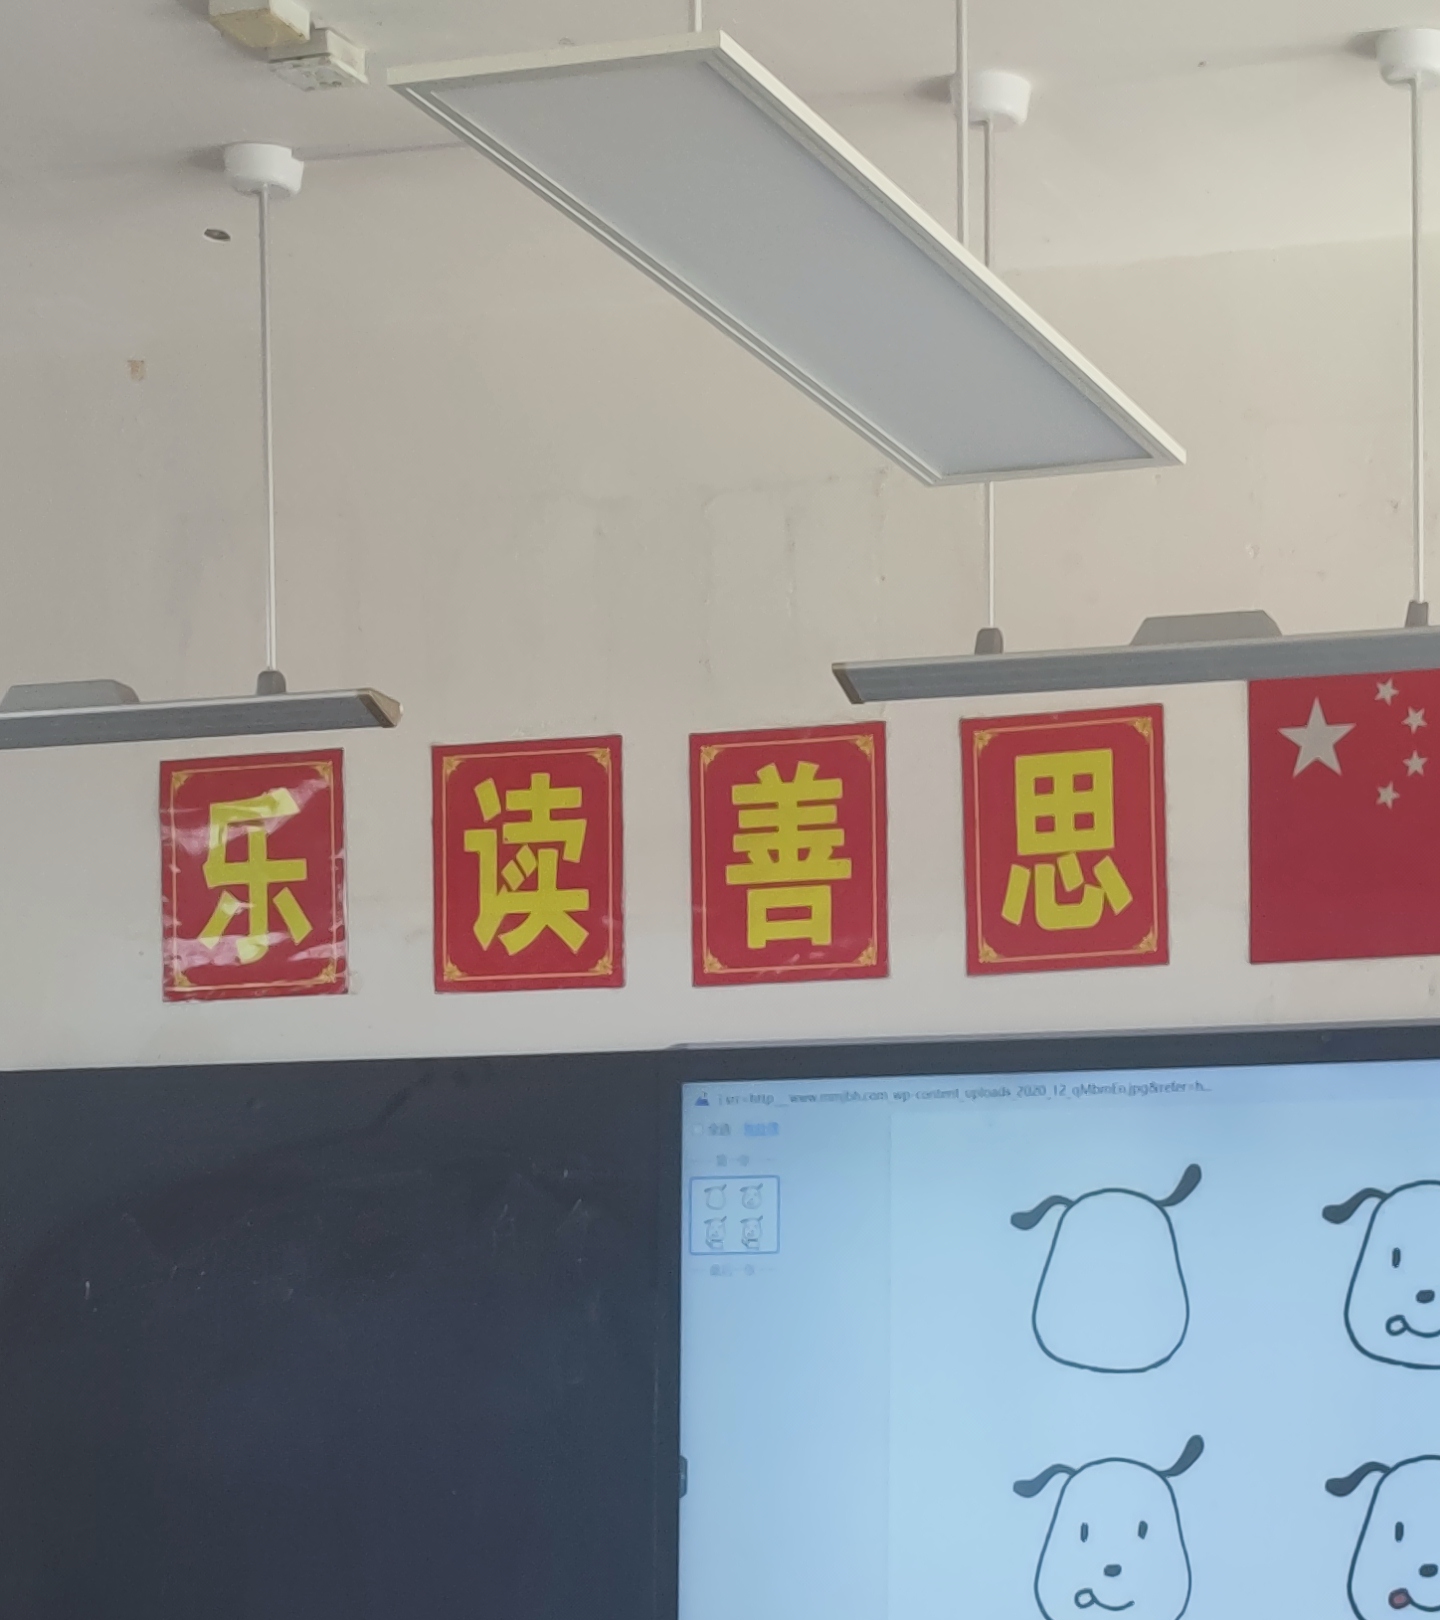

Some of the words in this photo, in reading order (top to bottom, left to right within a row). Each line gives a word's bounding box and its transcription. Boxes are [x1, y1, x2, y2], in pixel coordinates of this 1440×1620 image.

[201, 786, 311, 962] 乐
[464, 772, 590, 953] 读
[725, 762, 852, 948] 善
[1002, 748, 1132, 930] 思
